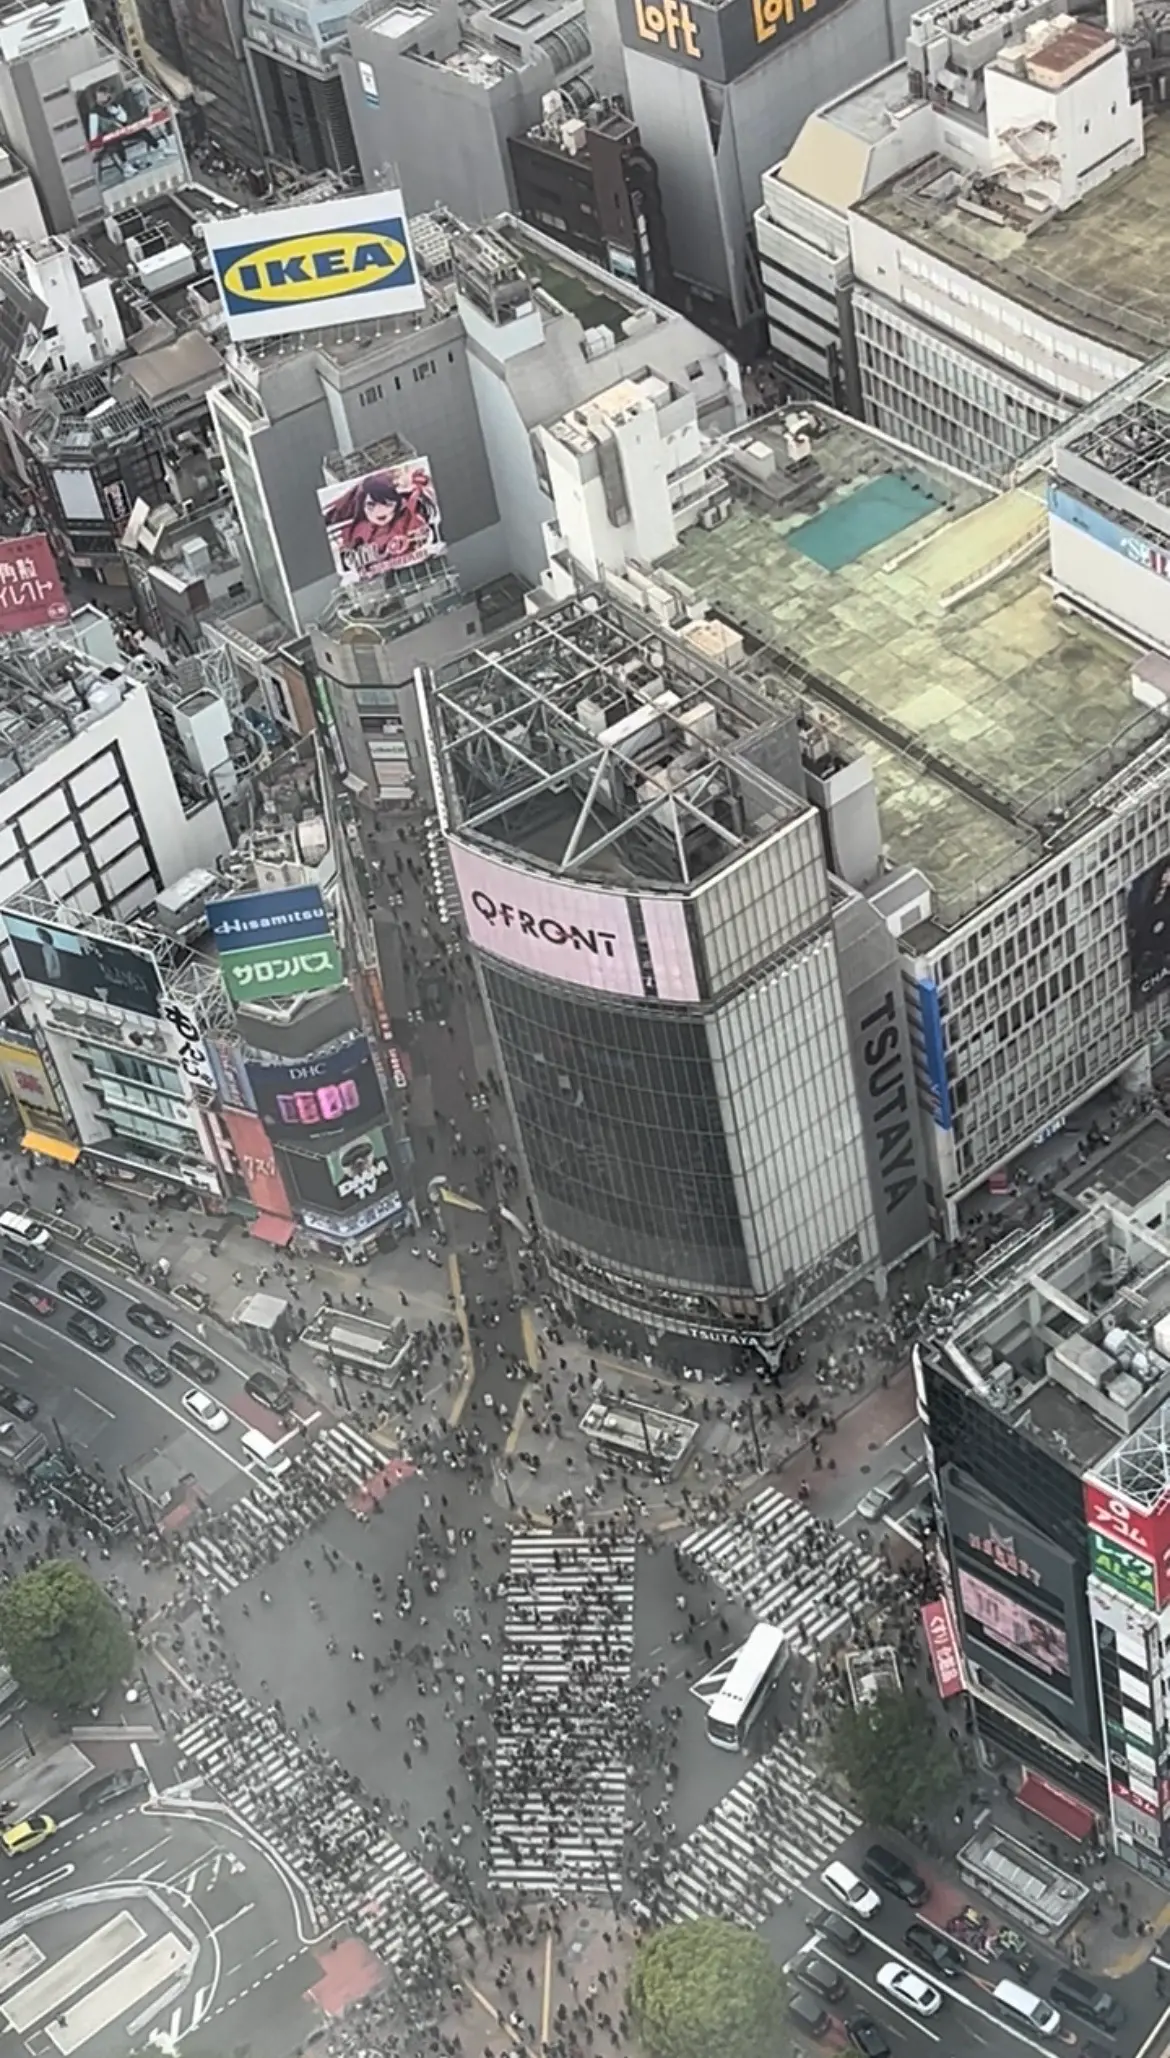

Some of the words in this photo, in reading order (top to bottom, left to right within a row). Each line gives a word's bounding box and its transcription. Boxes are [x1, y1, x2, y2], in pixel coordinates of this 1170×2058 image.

[238, 242, 395, 291] IKEA
[213, 907, 324, 934] Hisamitsu
[471, 890, 617, 958] QFRONT
[232, 951, 334, 985] サロンパス
[289, 1062, 327, 1080] DHC
[860, 991, 918, 1215] TSUTAYA
[338, 1160, 389, 1197] DMM
[354, 1177, 378, 1199] TV
[690, 1328, 759, 1346] TSUTAYA
[1095, 1534, 1153, 1577] レイク
[1095, 1554, 1154, 1597] ALSA
